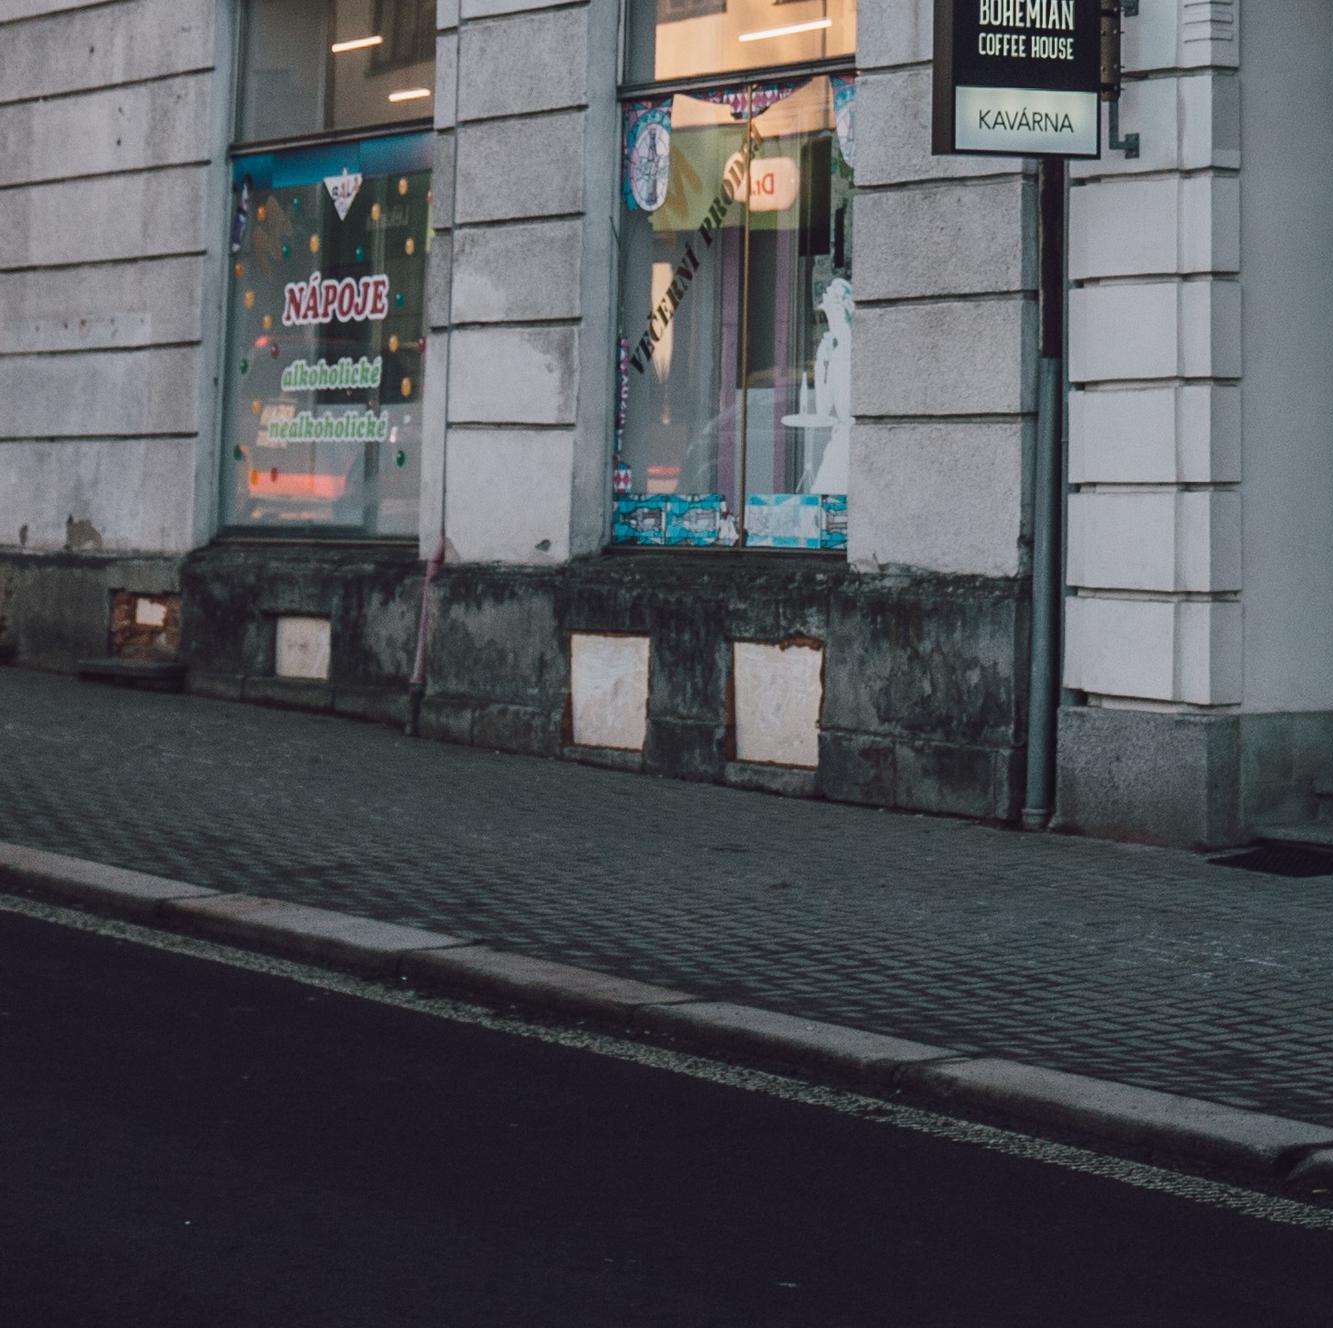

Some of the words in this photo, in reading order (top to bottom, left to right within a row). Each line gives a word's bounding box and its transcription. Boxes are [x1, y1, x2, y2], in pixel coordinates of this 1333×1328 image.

[977, 32, 1027, 58] COFFEE
[1030, 35, 1075, 61] HOUSE
[978, 106, 1075, 134] KAVÁRNA
[283, 273, 387, 323] NÁPOJE
[629, 240, 700, 374] VEČERNÍ
[282, 358, 381, 389] alkoholické
[269, 412, 388, 441] nealkoholické
